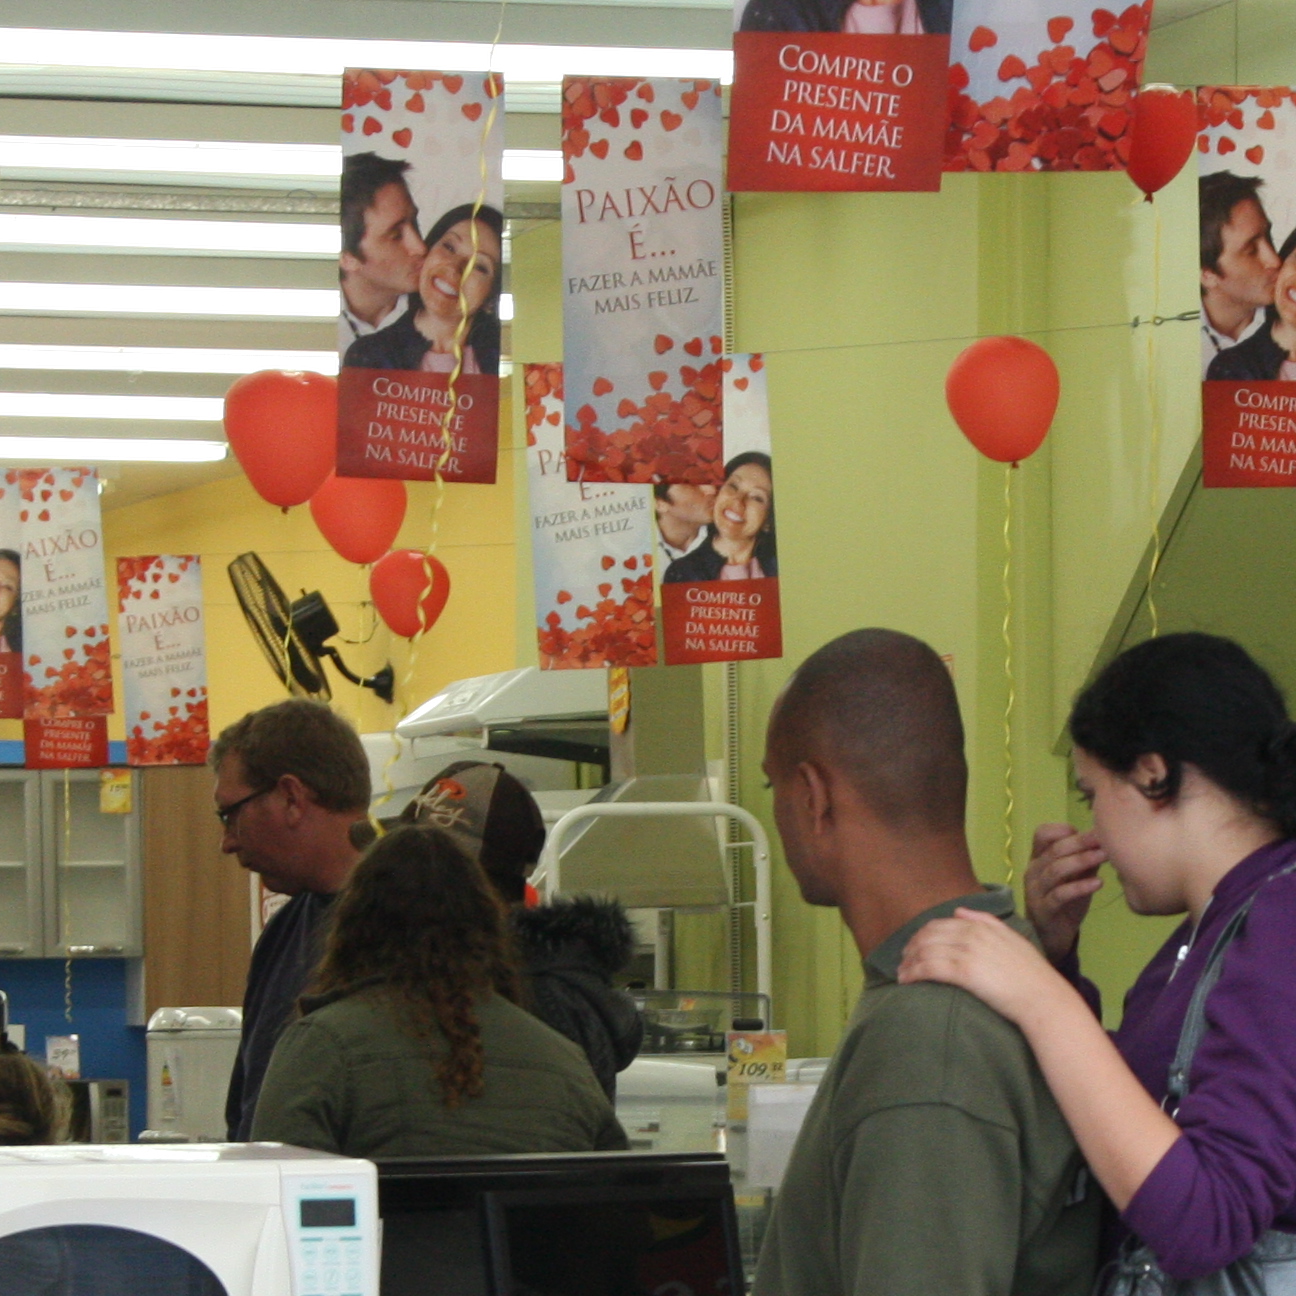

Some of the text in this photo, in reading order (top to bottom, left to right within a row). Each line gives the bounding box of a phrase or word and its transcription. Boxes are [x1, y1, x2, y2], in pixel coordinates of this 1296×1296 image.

[779, 44, 913, 87] COMPRE O
[784, 80, 900, 117] PRESENTE
[771, 109, 903, 148] DA MAMÃE
[767, 141, 895, 179] NA SALFER.
[575, 176, 715, 224] PAIXÃO
[628, 224, 676, 260] É...
[568, 259, 718, 295] FAZER A MAMÃE
[594, 295, 642, 316] MAIS
[1231, 433, 1255, 449] DA
[1230, 453, 1255, 470] NA
[686, 588, 761, 606] COMPRE O
[126, 605, 200, 634] PAIXÃO
[690, 606, 756, 621] PRESENTE
[686, 622, 759, 638] DA MAMÃE
[685, 639, 705, 651] NA
